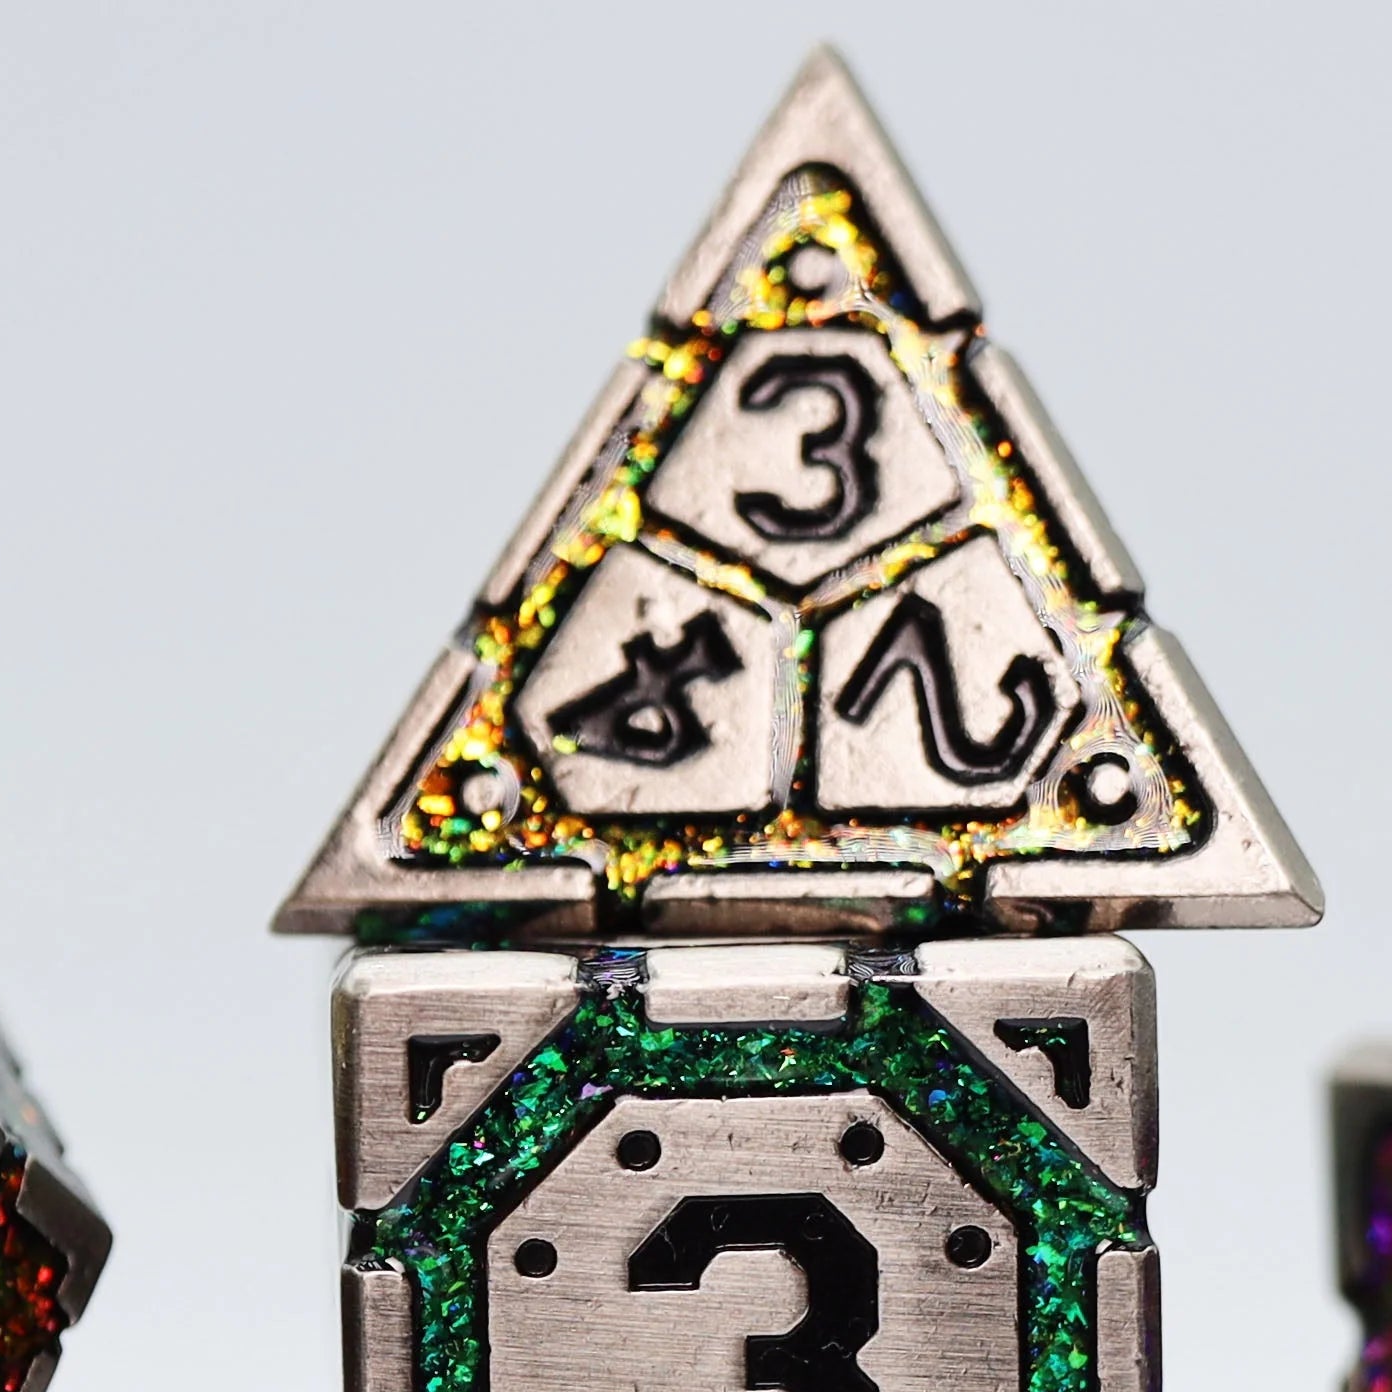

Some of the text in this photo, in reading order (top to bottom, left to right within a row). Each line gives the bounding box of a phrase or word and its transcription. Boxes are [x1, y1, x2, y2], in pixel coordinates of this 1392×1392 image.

[732, 353, 882, 542] 3
[546, 611, 745, 768] 4
[834, 592, 1058, 784] 2
